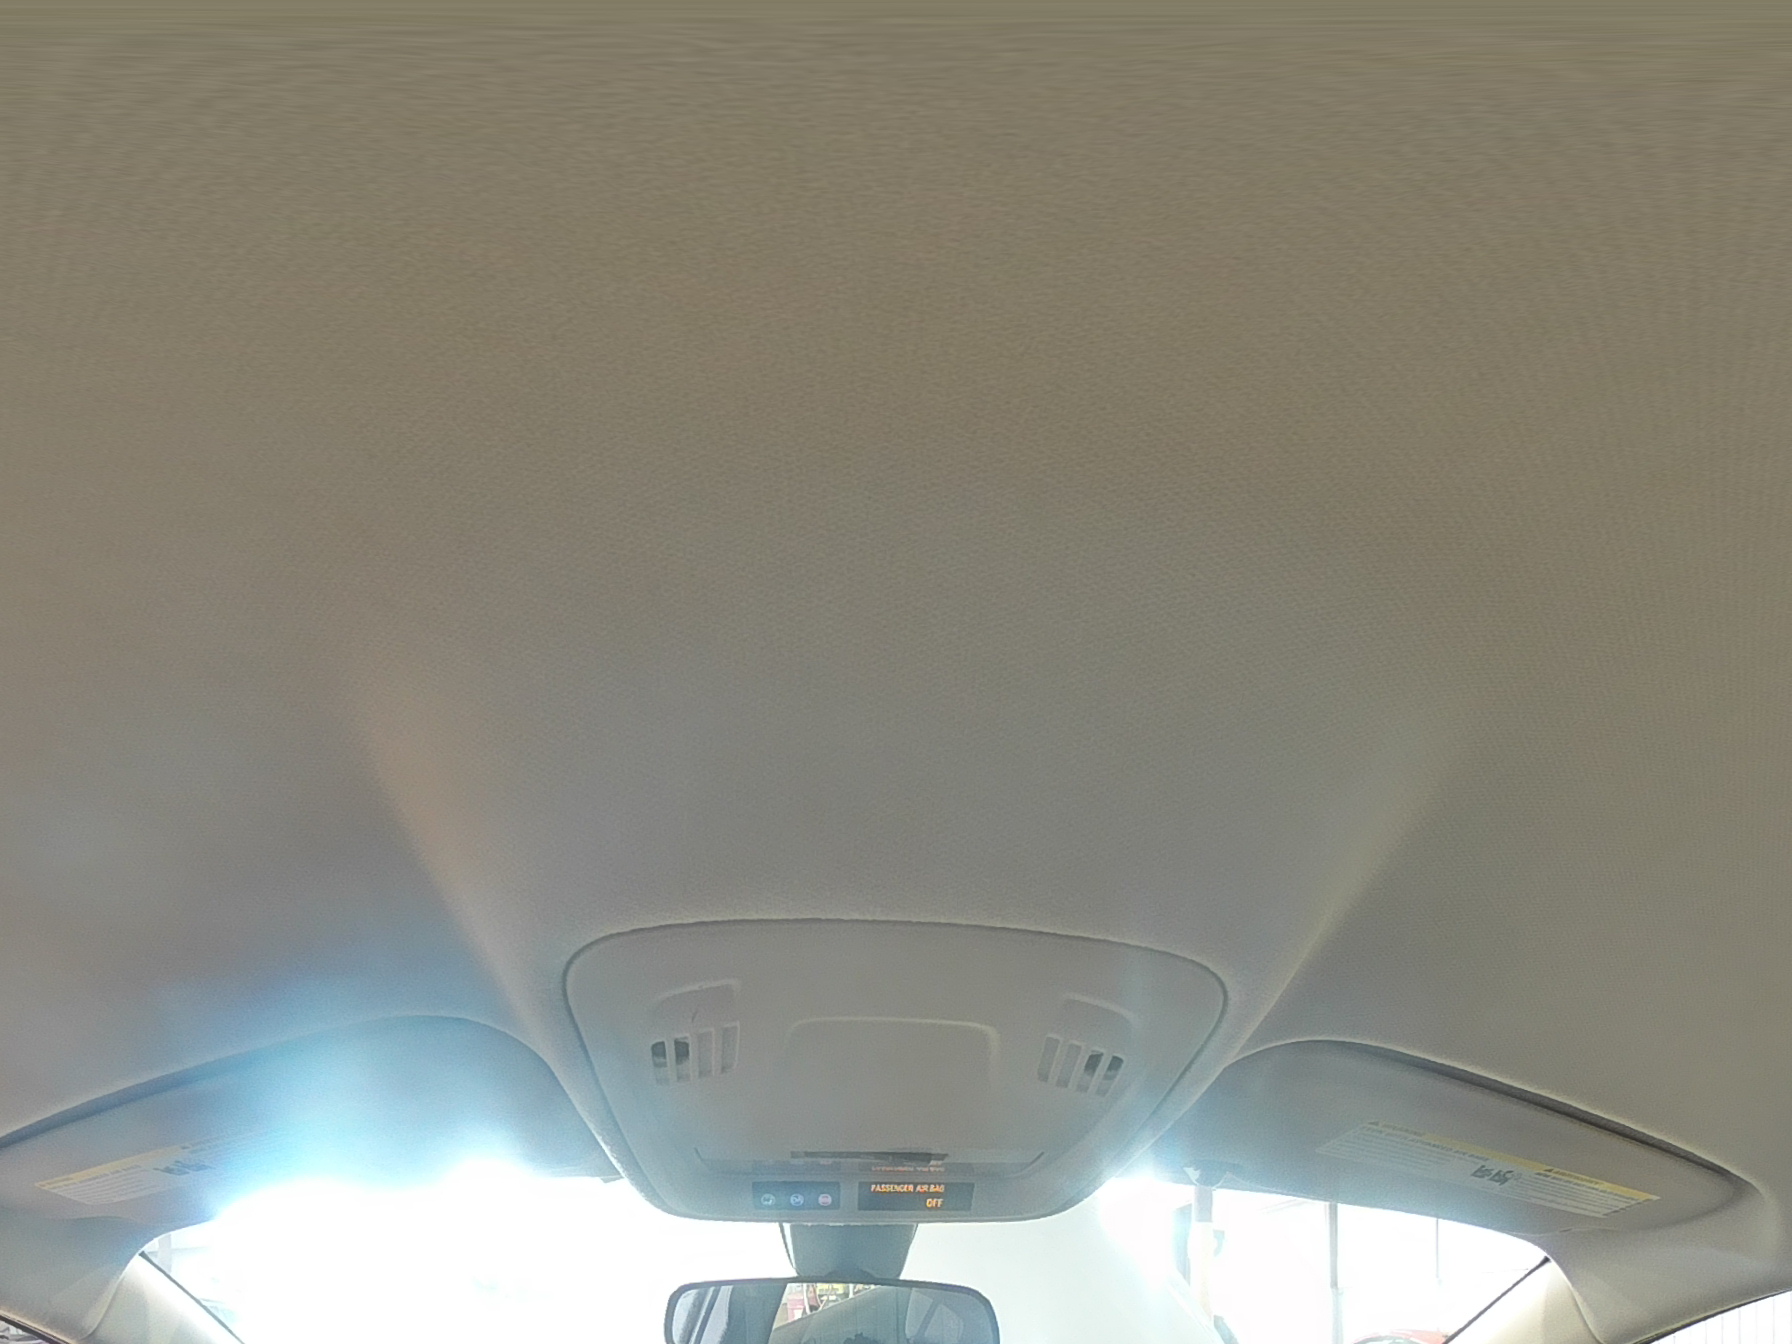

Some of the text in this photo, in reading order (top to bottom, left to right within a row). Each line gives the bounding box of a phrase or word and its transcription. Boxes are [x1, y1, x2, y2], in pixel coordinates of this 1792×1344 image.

[870, 1184, 914, 1193] PASSENGER
[915, 1184, 929, 1193] AIR
[925, 1198, 944, 1208] OFF
